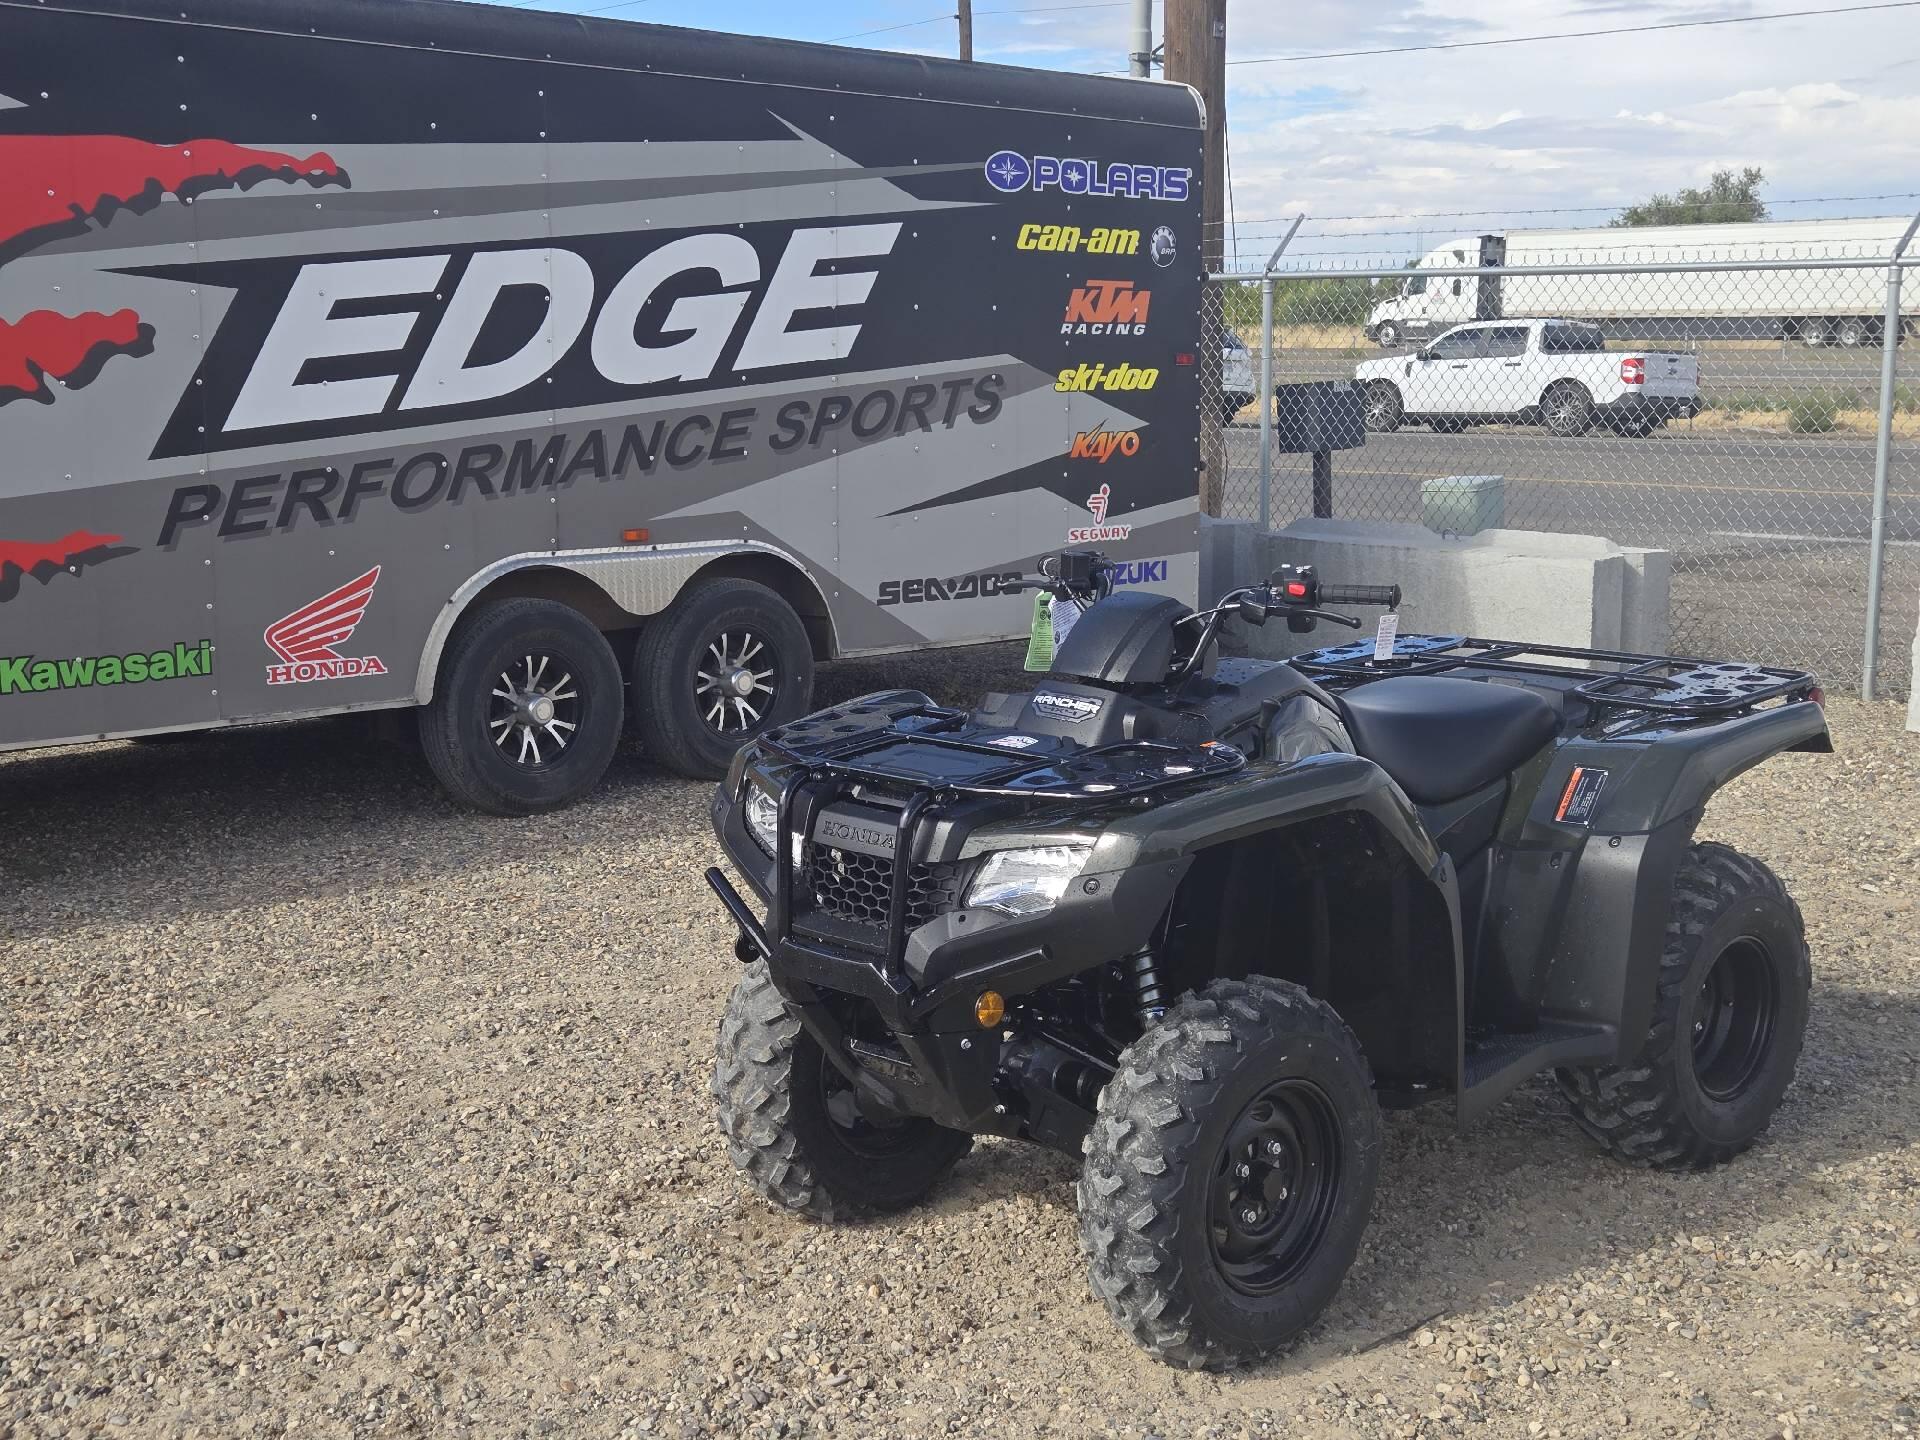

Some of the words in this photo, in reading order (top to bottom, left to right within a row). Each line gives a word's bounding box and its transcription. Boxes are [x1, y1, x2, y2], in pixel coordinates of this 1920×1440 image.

[1033, 156, 1189, 202] POLARIS
[1160, 247, 1176, 256] BRP
[1065, 280, 1151, 323] KTM
[221, 222, 903, 433] EDGE
[1061, 323, 1146, 336] RACING
[1054, 363, 1159, 392] ski-doo
[156, 407, 757, 548] PERFORMANCE
[767, 373, 1006, 453] SPORTS
[1069, 527, 1130, 542] SEGWAY
[1103, 559, 1168, 586] ZUKI
[0, 640, 213, 694] Kawasaki
[266, 656, 387, 684] HONDA
[1033, 695, 1100, 714] RANCHER
[822, 820, 896, 850] HONDA
